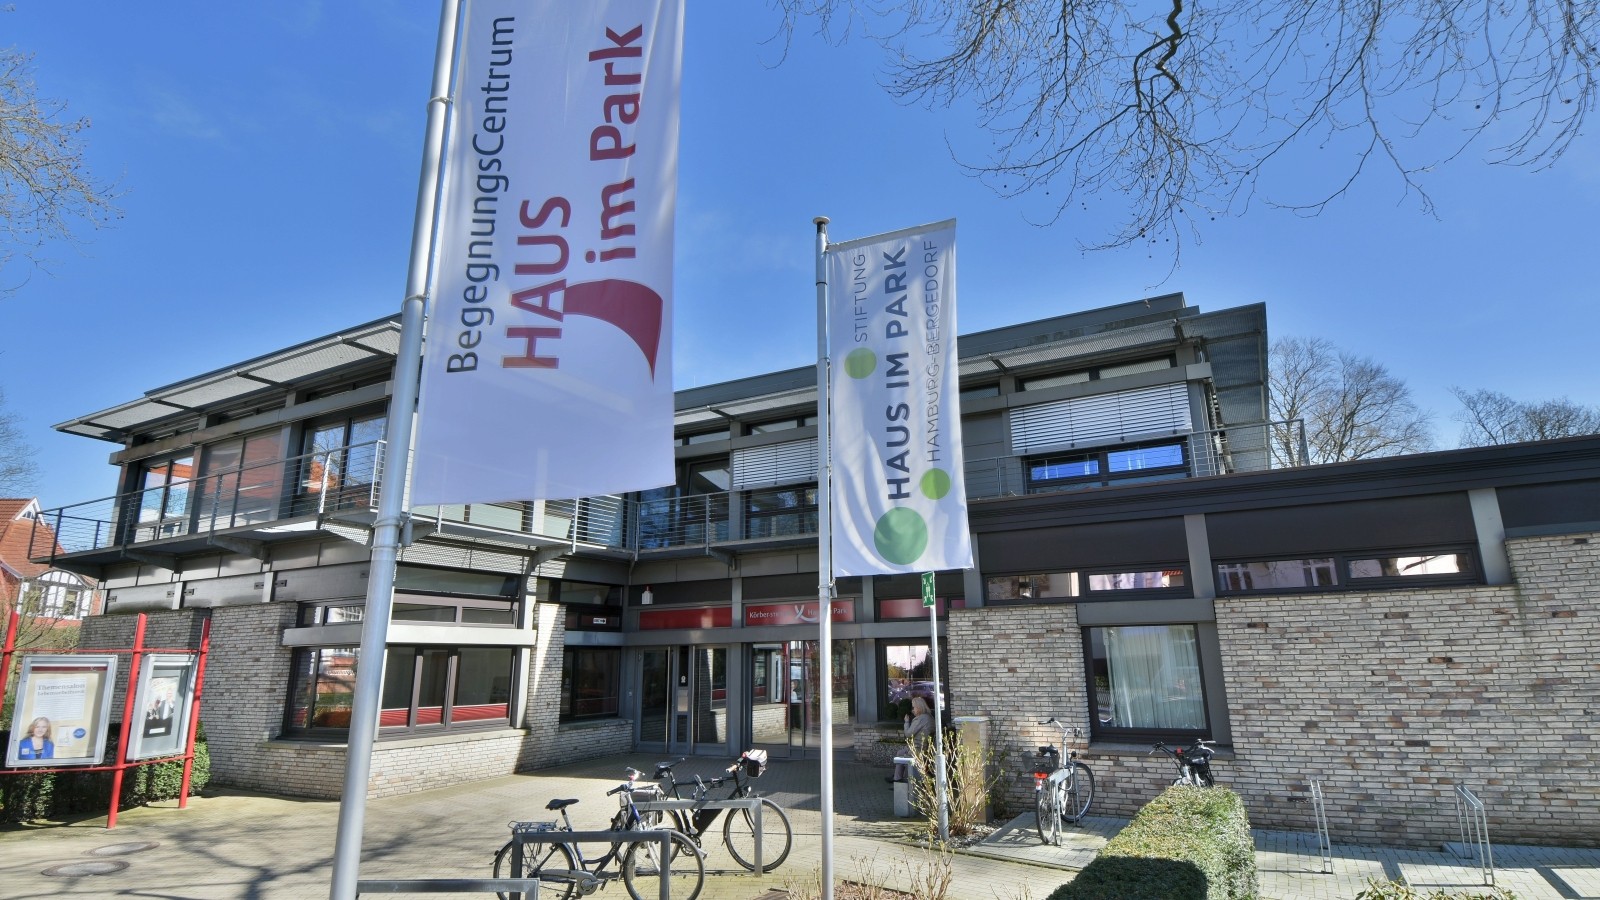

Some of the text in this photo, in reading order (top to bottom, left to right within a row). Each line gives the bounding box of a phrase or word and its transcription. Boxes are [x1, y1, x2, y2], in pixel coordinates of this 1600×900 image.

[446, 16, 516, 374] BegegnungsCentrum
[585, 23, 643, 264] im Park
[502, 196, 572, 370] HAUS
[853, 253, 868, 343] STIFTUNG
[883, 246, 911, 500] HAUS IM PARK
[923, 240, 941, 463] HAMBURG-BERGEDORF
